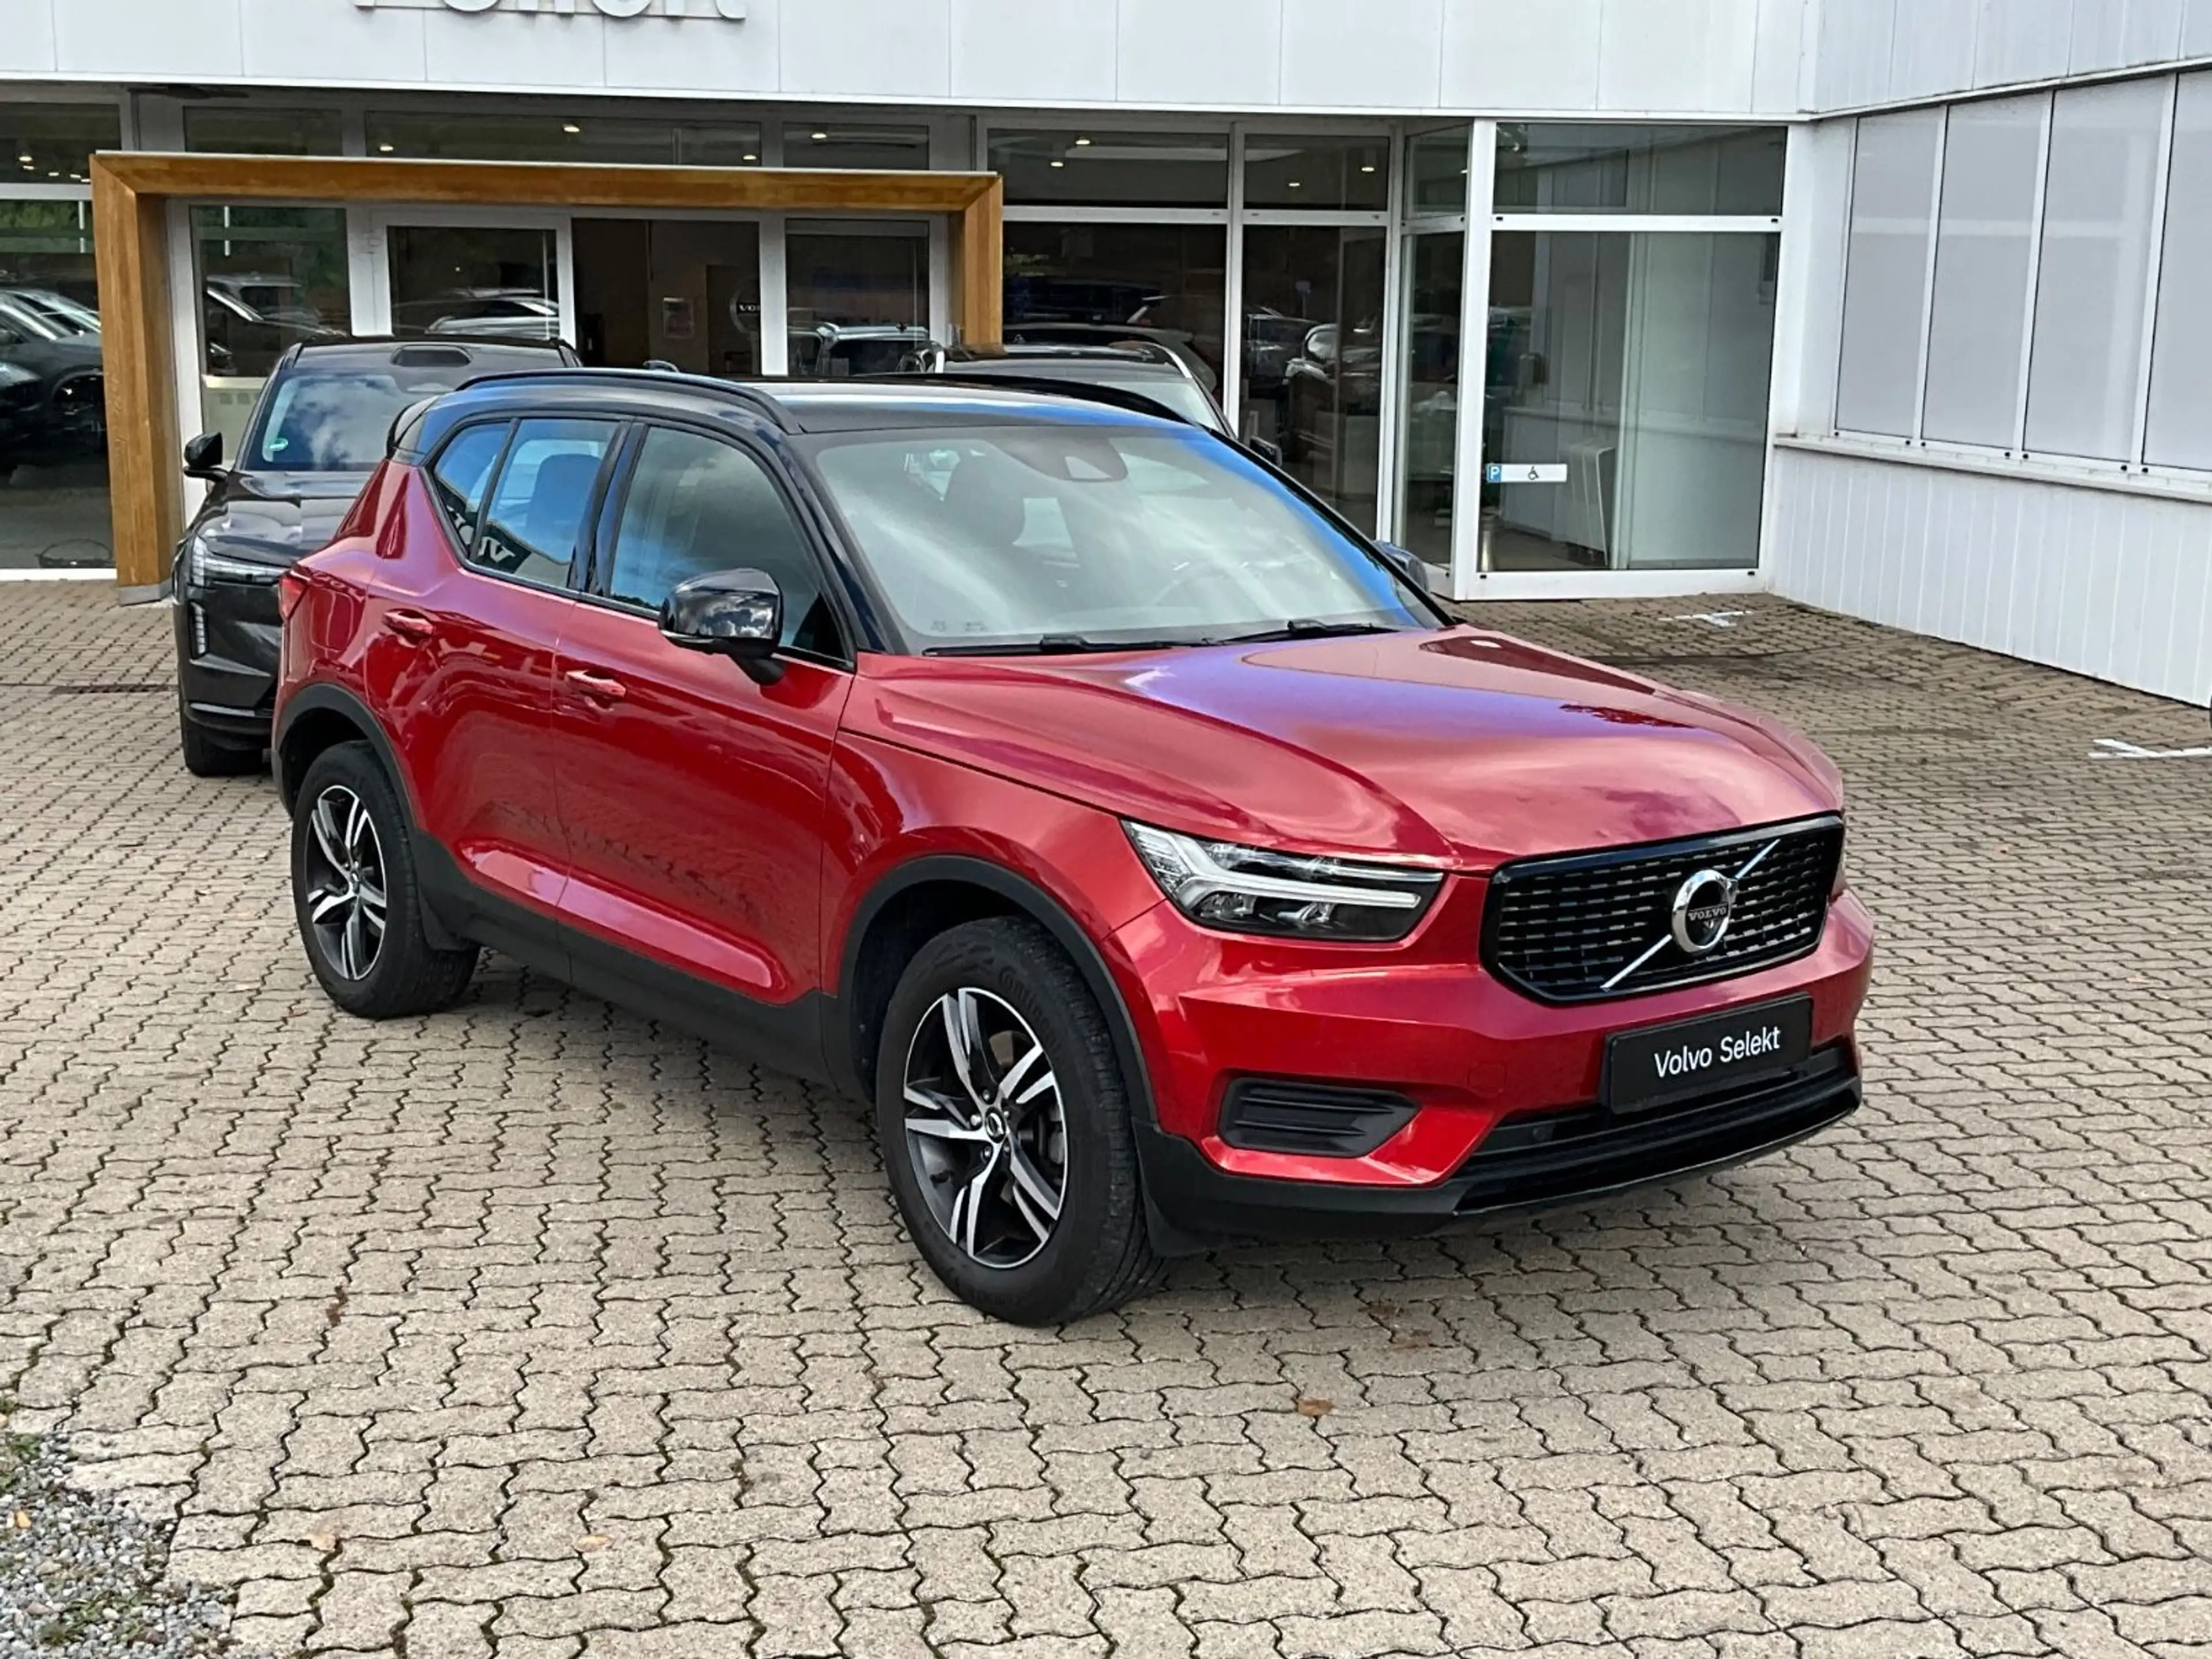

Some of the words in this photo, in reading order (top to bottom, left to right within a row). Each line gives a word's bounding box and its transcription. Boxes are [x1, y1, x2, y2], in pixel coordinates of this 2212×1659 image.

[1490, 465, 1500, 480] P
[1688, 907, 1726, 921] VOLVO
[1654, 1045, 1713, 1078] Volvo
[1719, 1026, 1781, 1063] Selekt
